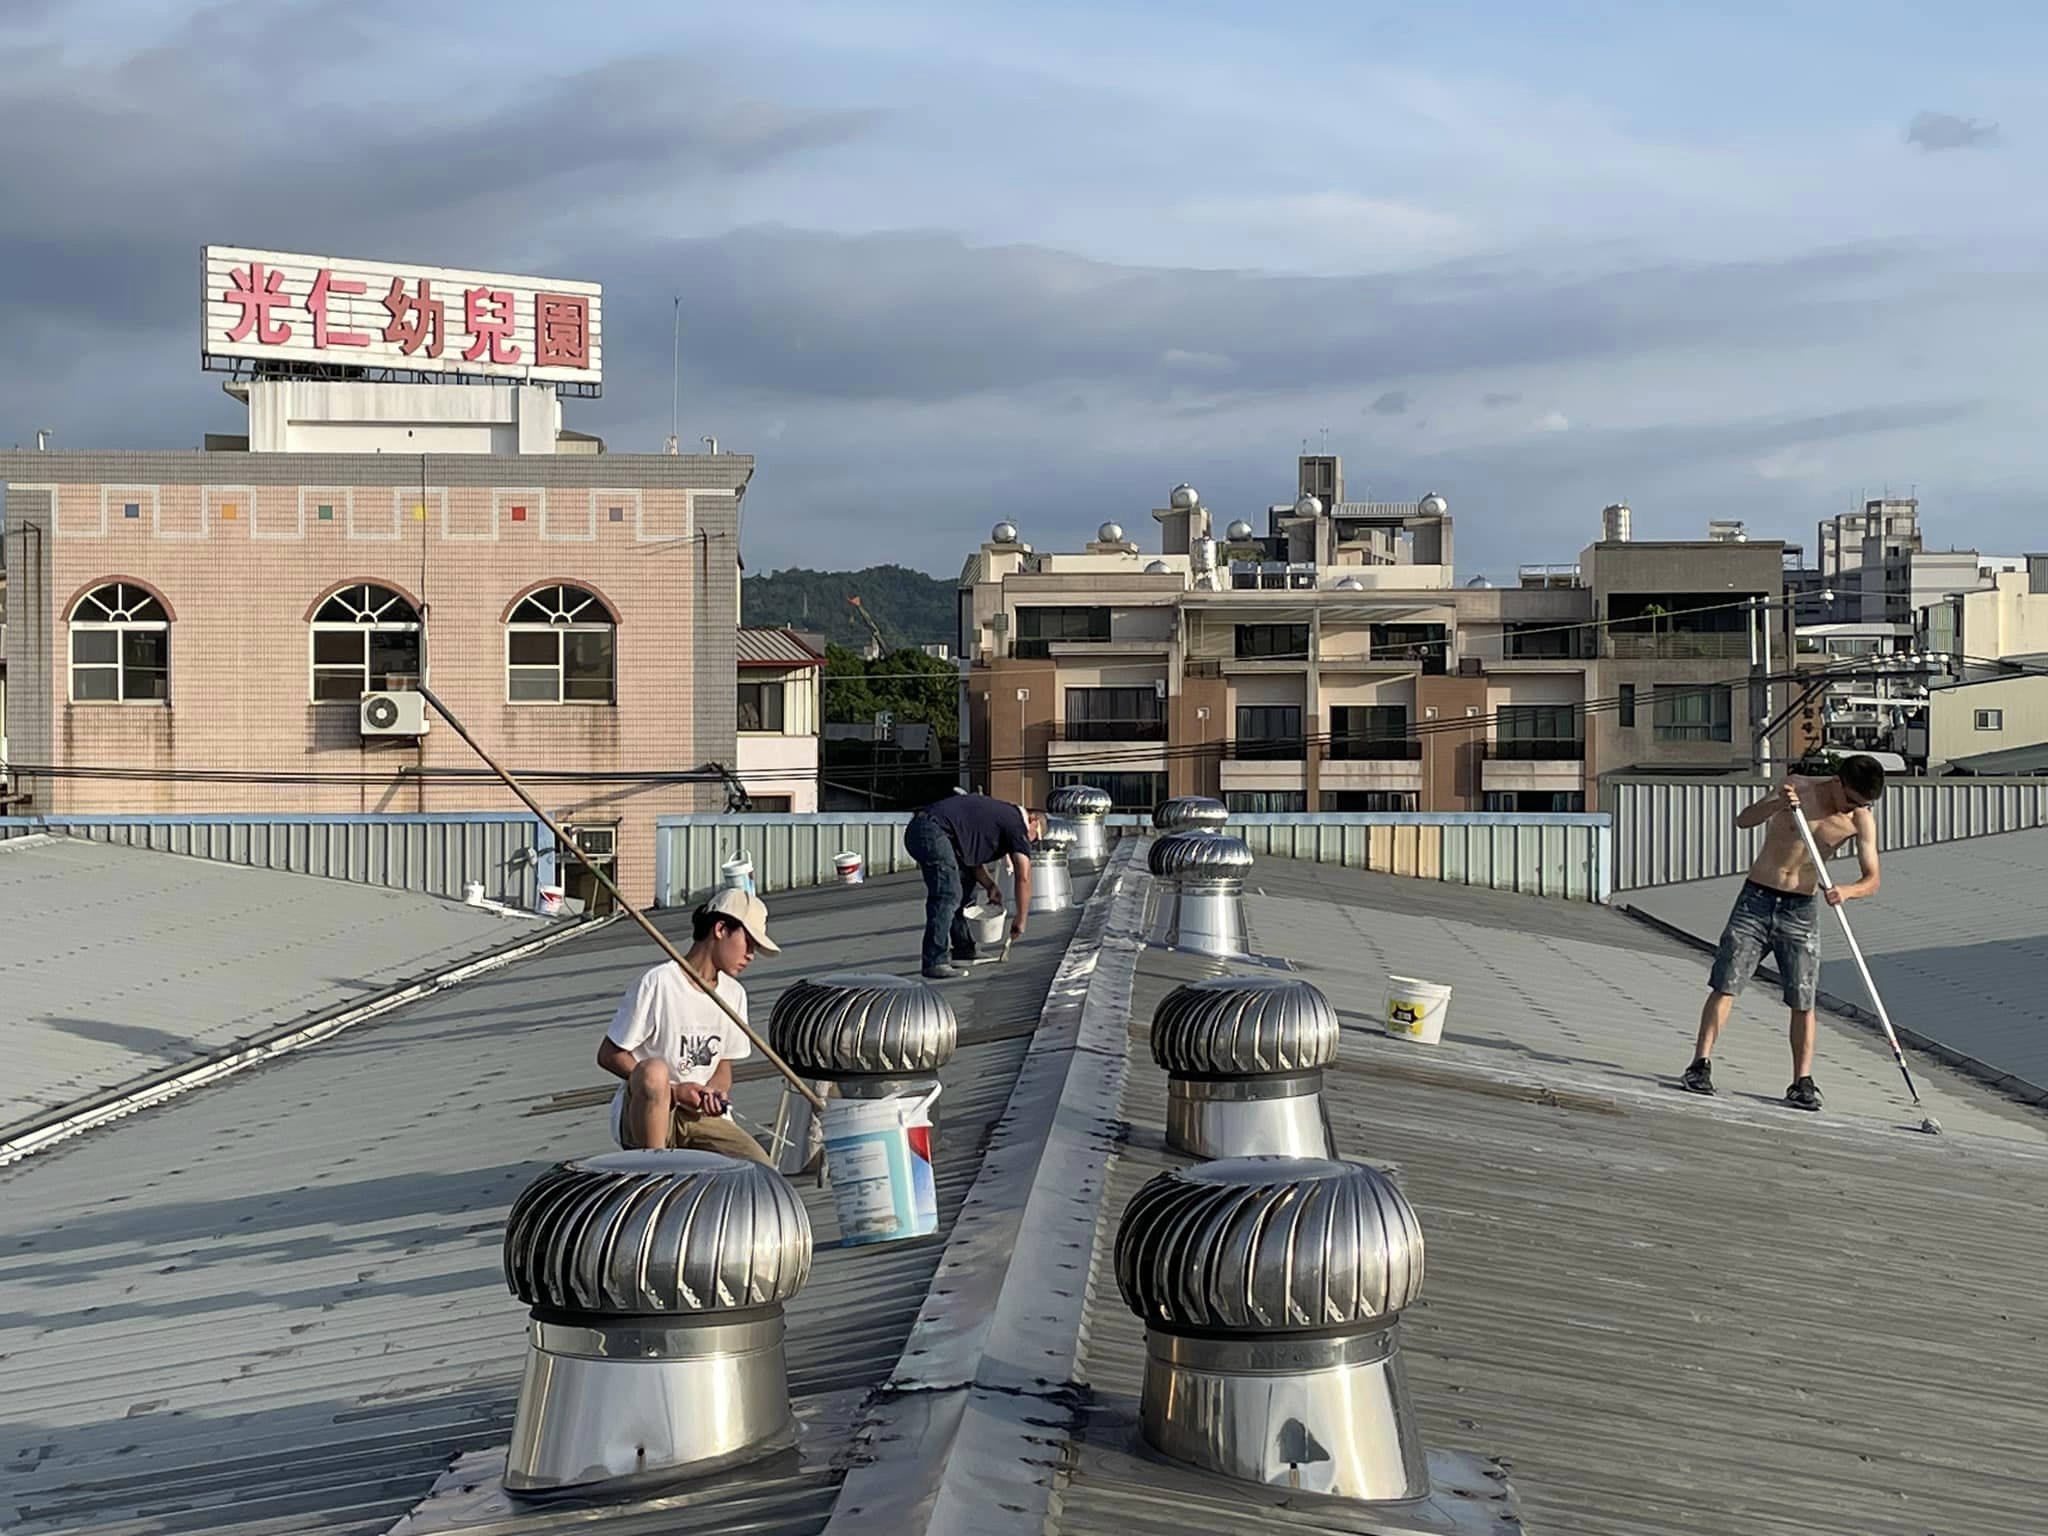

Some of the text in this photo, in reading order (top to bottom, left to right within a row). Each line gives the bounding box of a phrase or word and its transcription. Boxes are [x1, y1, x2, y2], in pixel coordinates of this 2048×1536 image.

[224, 263, 590, 370] 光仁幼兒園
